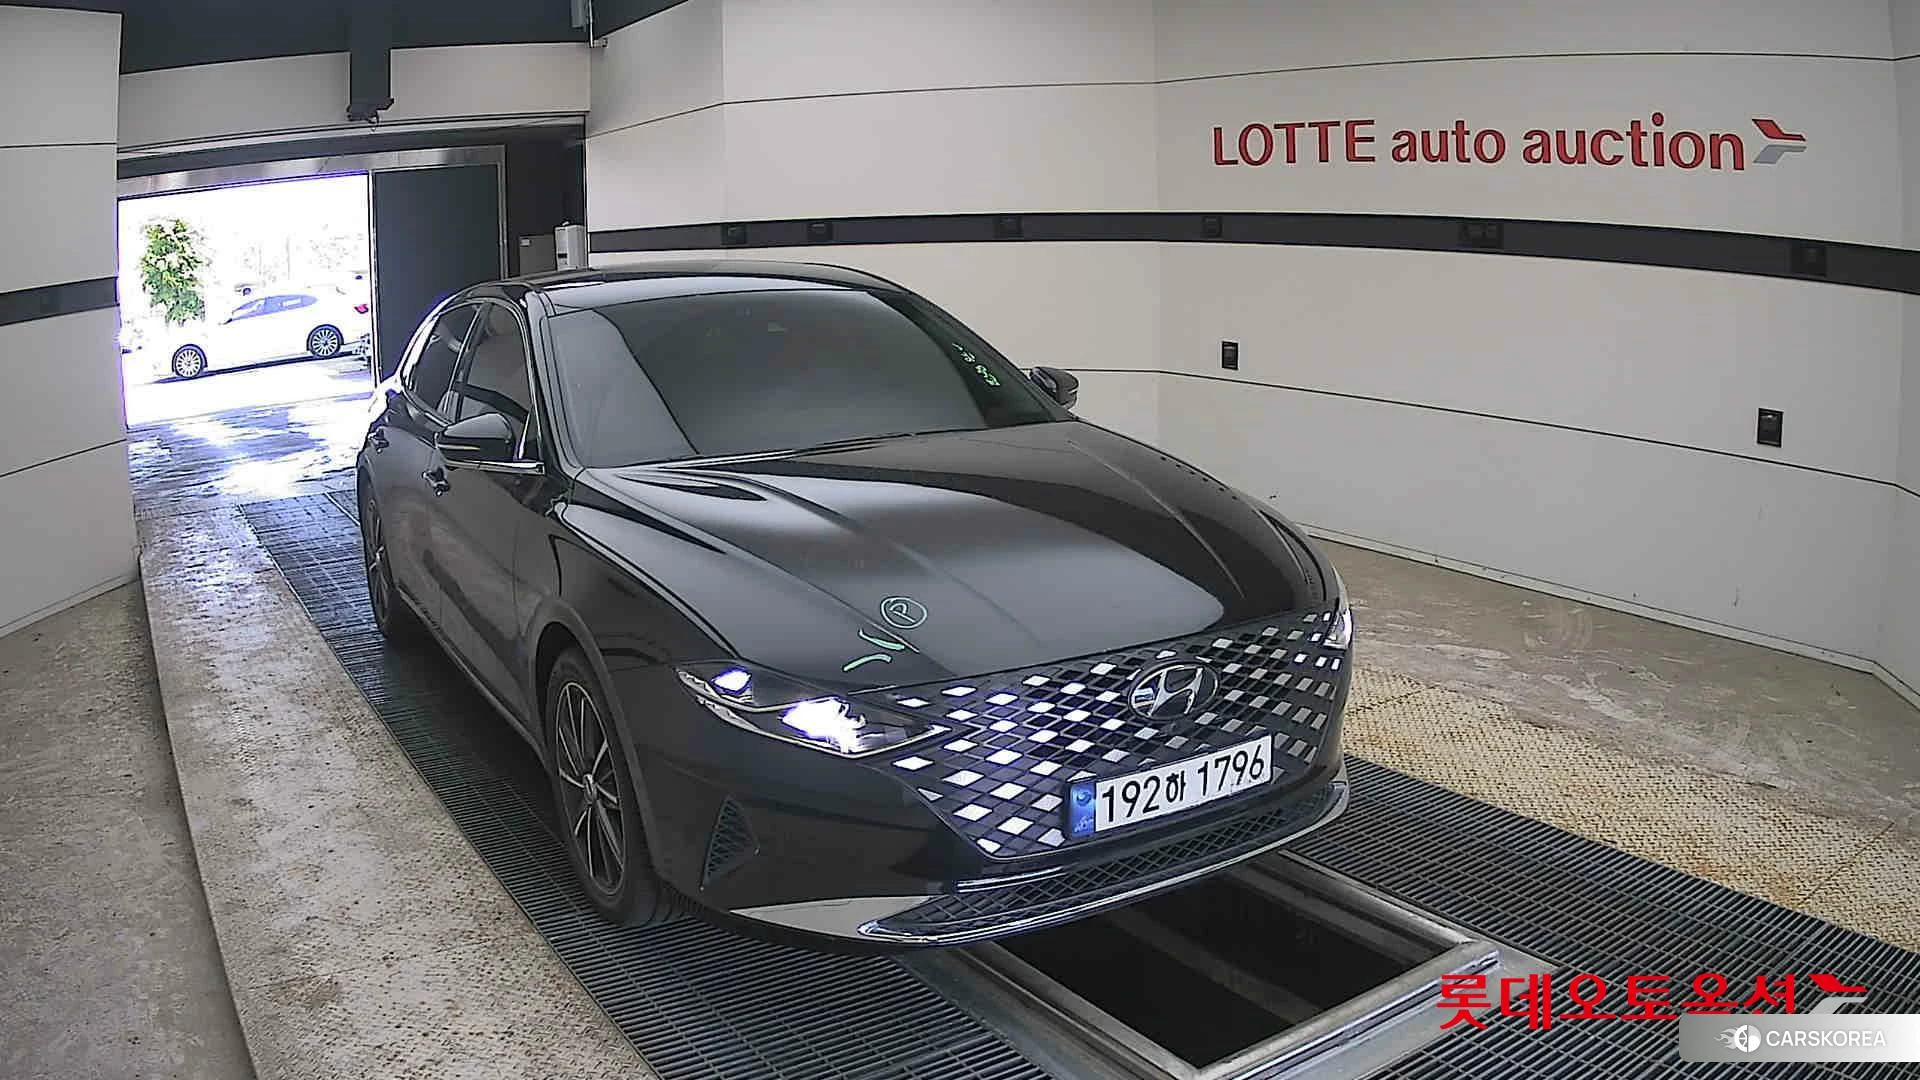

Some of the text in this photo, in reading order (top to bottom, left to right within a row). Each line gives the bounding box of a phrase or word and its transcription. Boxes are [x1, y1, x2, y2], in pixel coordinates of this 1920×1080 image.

[1213, 112, 1745, 170] LOTTE auto auction
[1102, 744, 1265, 823] 192하 1796
